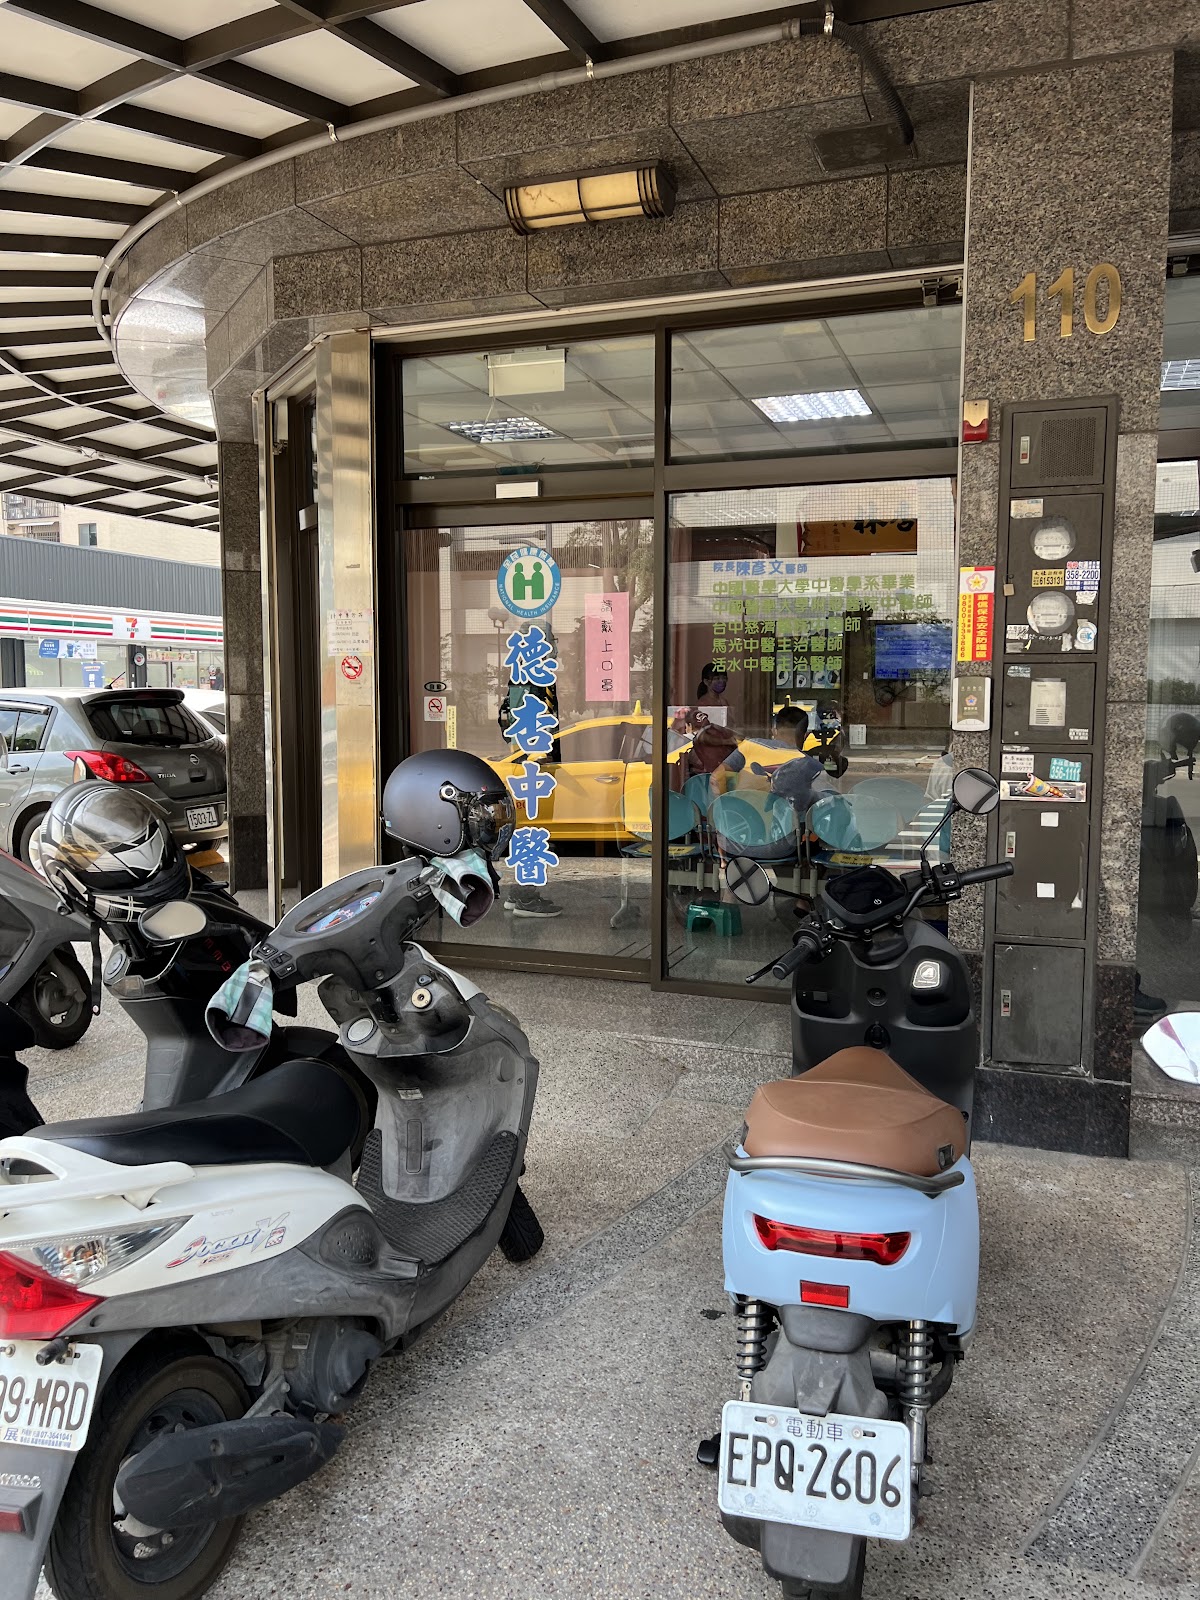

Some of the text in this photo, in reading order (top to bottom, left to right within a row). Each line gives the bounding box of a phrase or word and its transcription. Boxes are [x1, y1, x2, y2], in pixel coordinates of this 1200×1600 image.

[1010, 263, 1122, 342] 110
[1066, 570, 1100, 580] 358-2200
[516, 609, 538, 617] HEALTH
[126, 617, 138, 638] 7
[601, 599, 614, 692] 請戴上口罩
[712, 636, 844, 653] 馬光中醫主治醫師
[712, 655, 843, 673] 活水中醫主治醫師
[505, 625, 560, 887] 德杏中醫
[1051, 765, 1081, 781] 356-1111
[189, 811, 217, 827] 1503-ZL
[785, 1415, 844, 1442] 電動車
[726, 1431, 902, 1508] EPQ-2606
